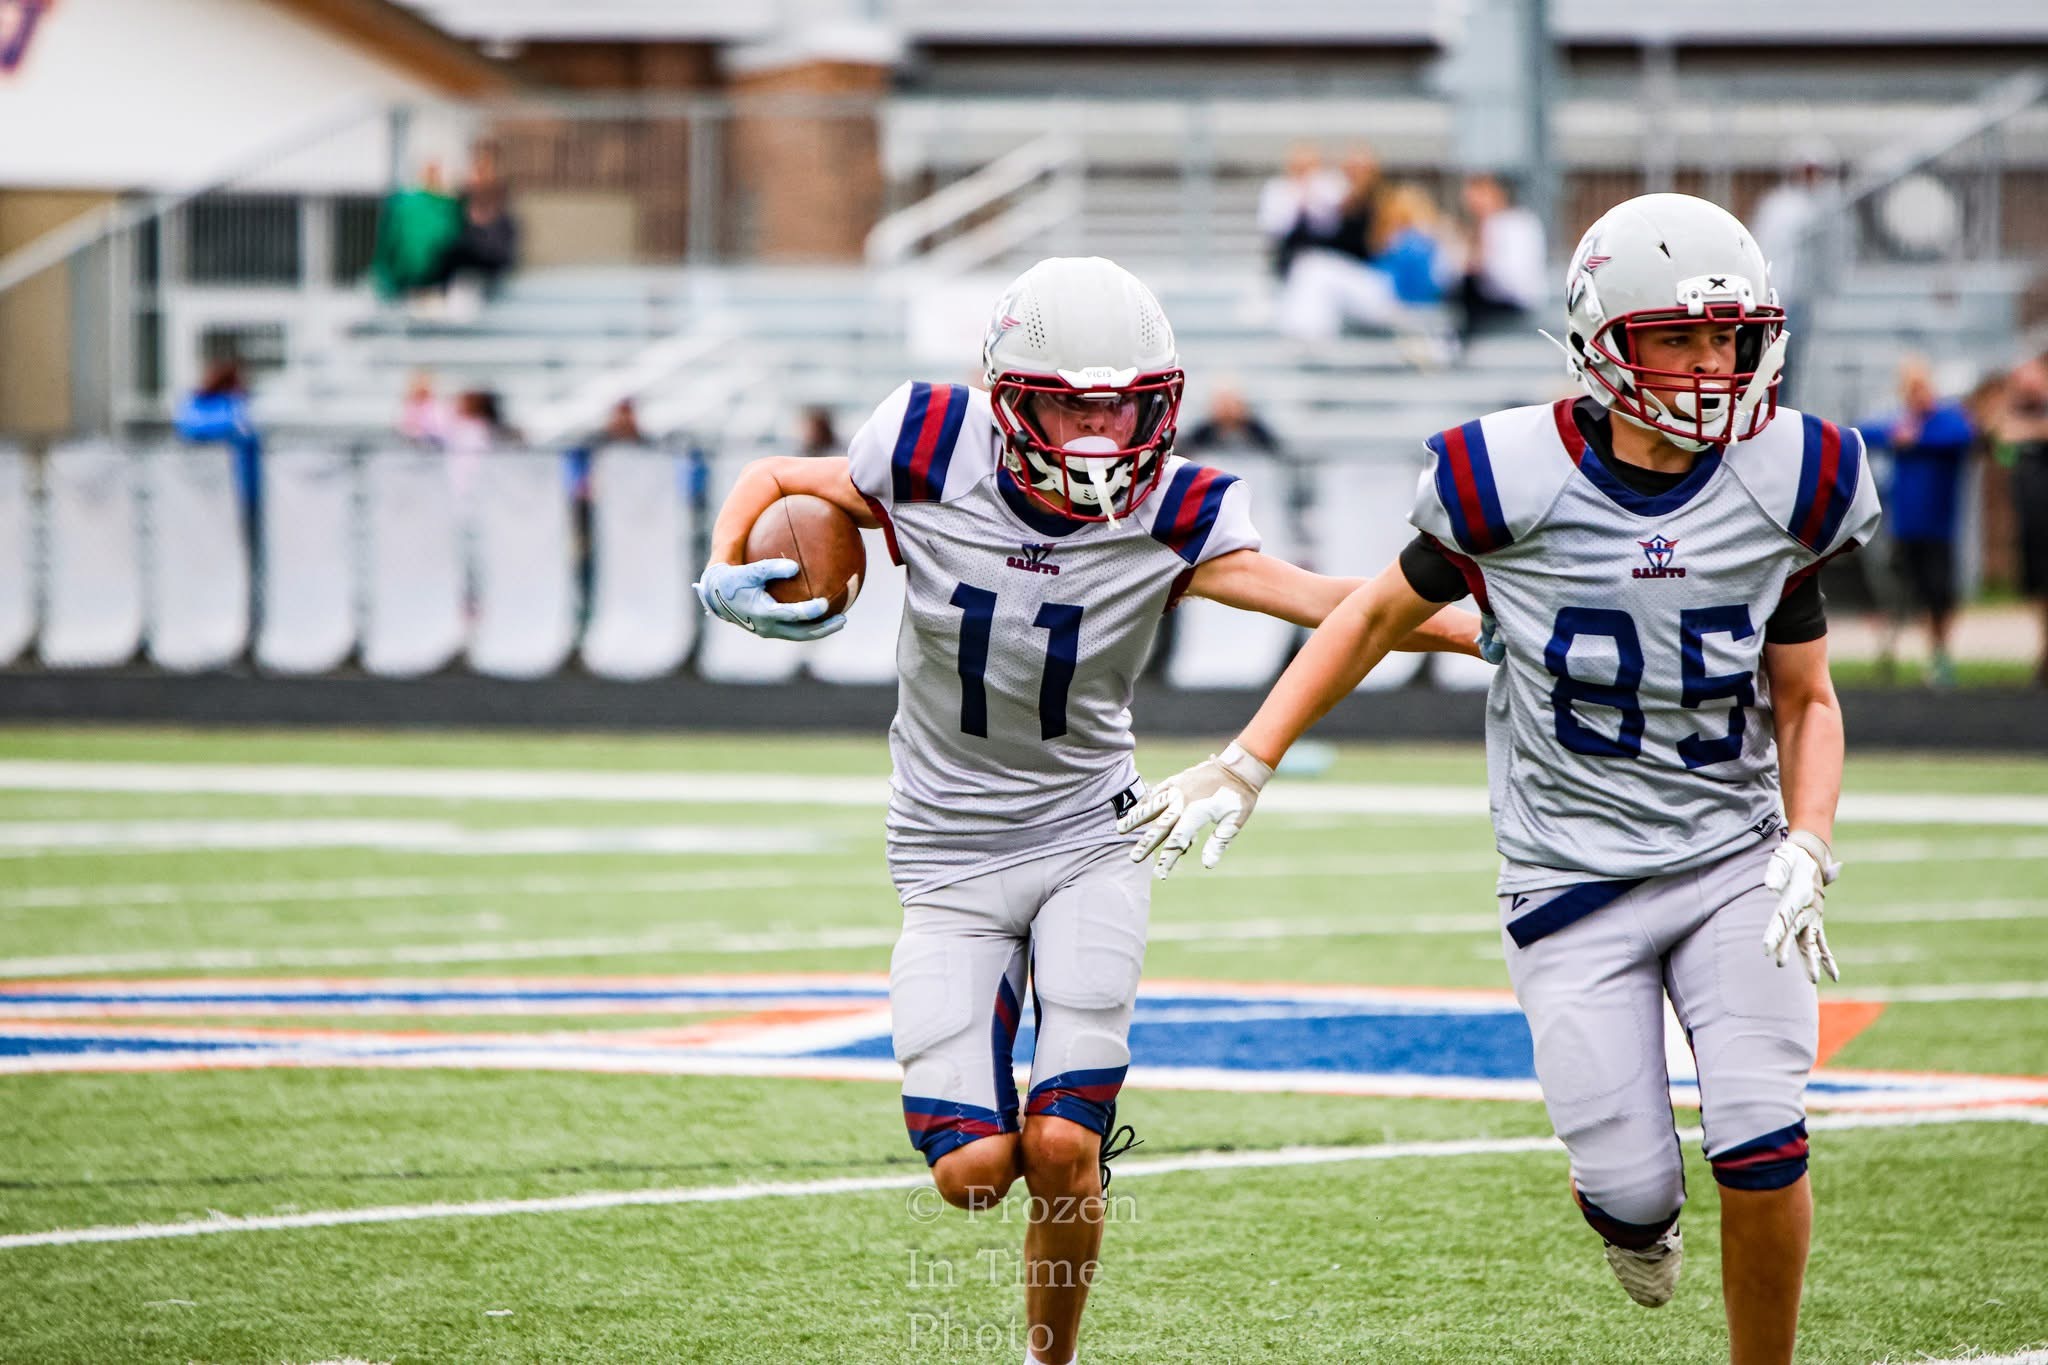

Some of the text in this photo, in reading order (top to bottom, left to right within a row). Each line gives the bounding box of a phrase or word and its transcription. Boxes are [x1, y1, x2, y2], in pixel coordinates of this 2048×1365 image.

[1086, 370, 1112, 378] VICIS
[1006, 556, 1060, 576] SAINTS
[1632, 567, 1687, 579] SAINTS
[949, 581, 1084, 741] 11
[1544, 603, 1755, 769] 85
